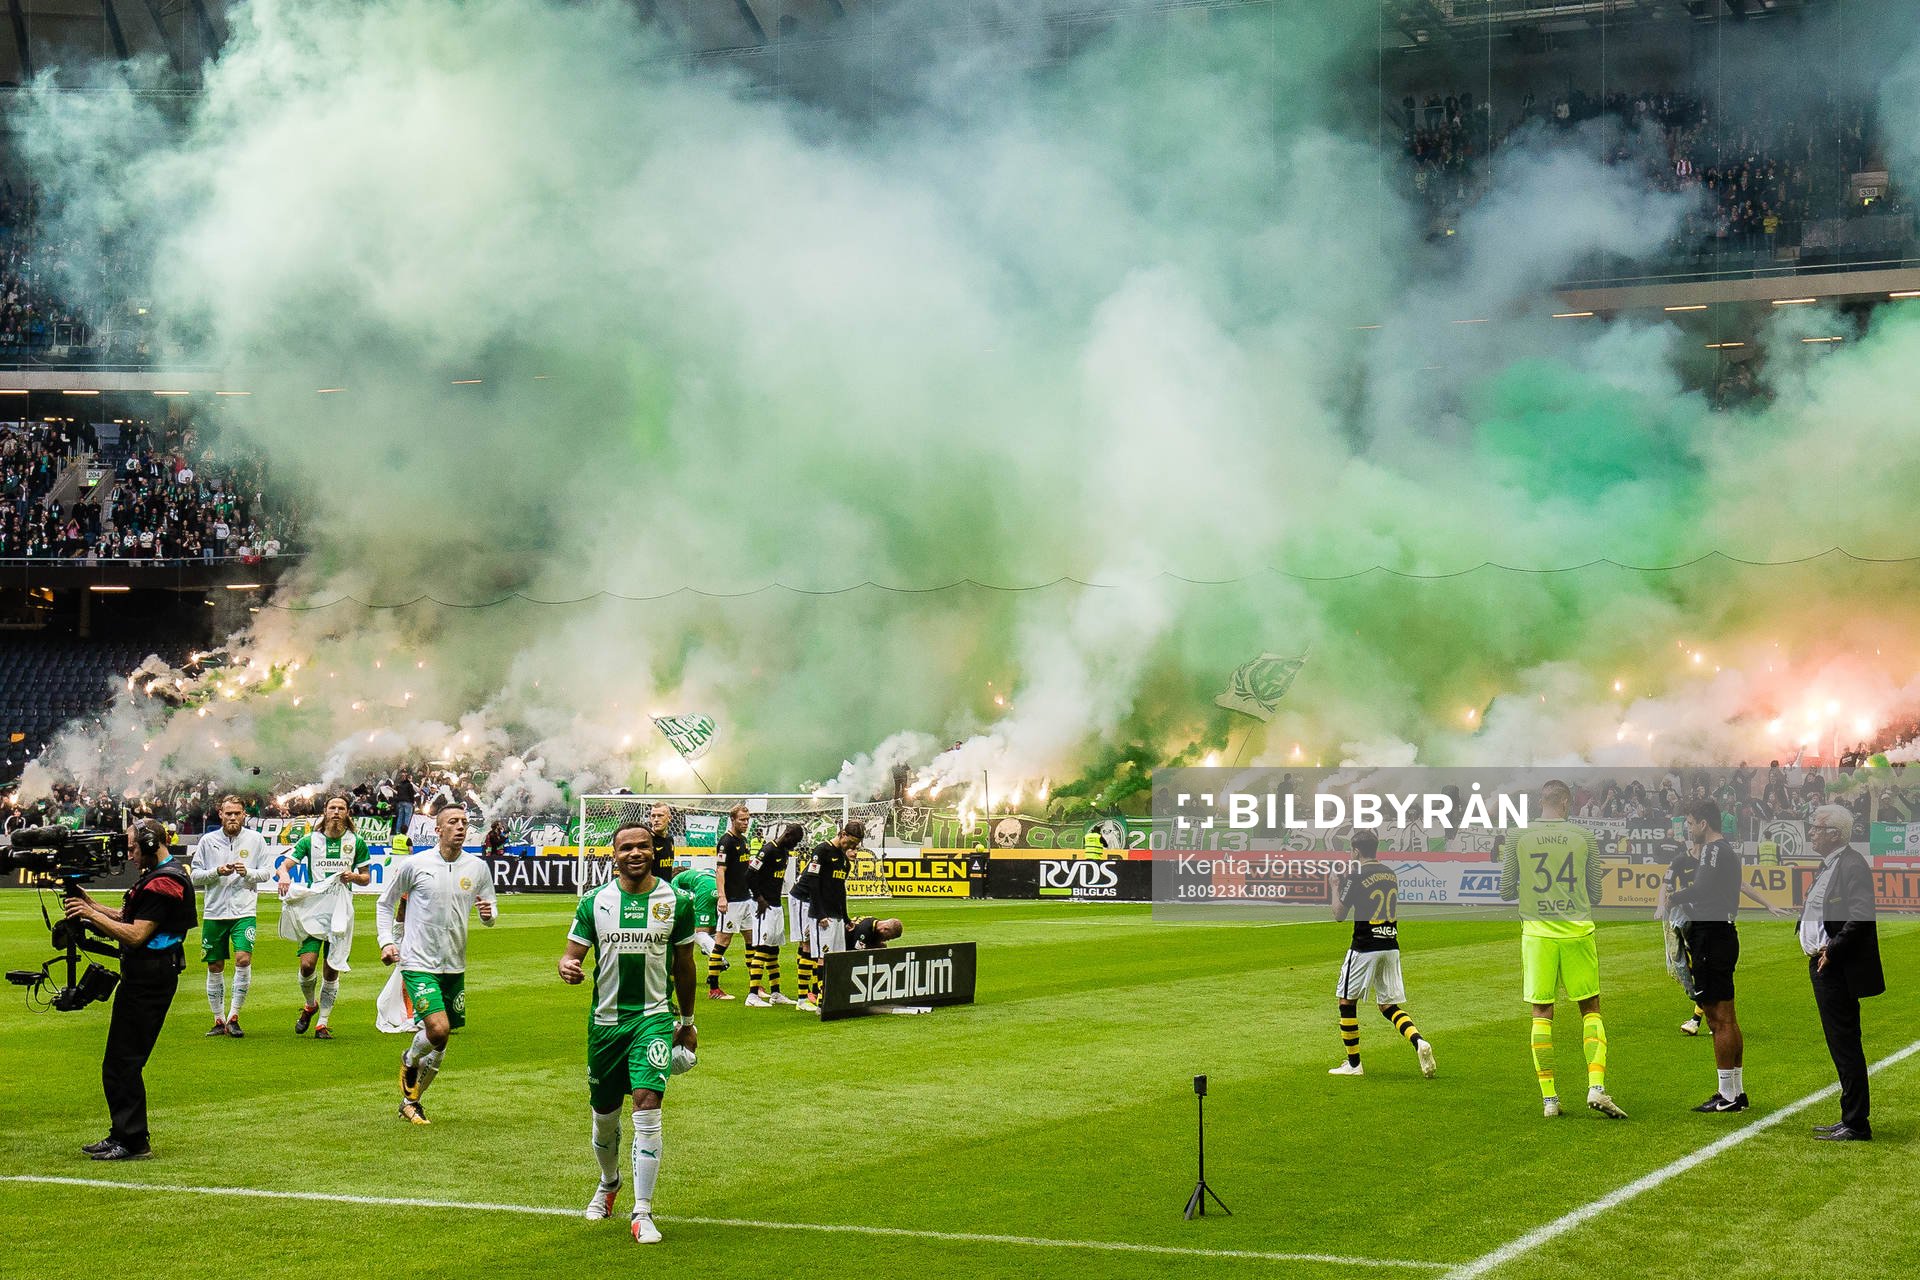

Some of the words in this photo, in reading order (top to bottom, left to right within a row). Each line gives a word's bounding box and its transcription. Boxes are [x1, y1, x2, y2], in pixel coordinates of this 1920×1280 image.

[1537, 834, 1568, 845] LINNÉR
[1040, 861, 1118, 887] RYDS
[1530, 852, 1577, 893] 34
[1398, 877, 1447, 887] rodukter
[1750, 869, 1787, 890] AB
[917, 884, 953, 893] NACKA
[1073, 888, 1117, 896] BILGLAS
[1397, 890, 1423, 900] den
[1429, 890, 1447, 900] AB
[1618, 895, 1656, 903] Balkonger
[1369, 888, 1397, 924] 20
[1537, 899, 1576, 911] SVEA
[605, 932, 665, 943] JOBMAN
[849, 952, 953, 1004] stadium
